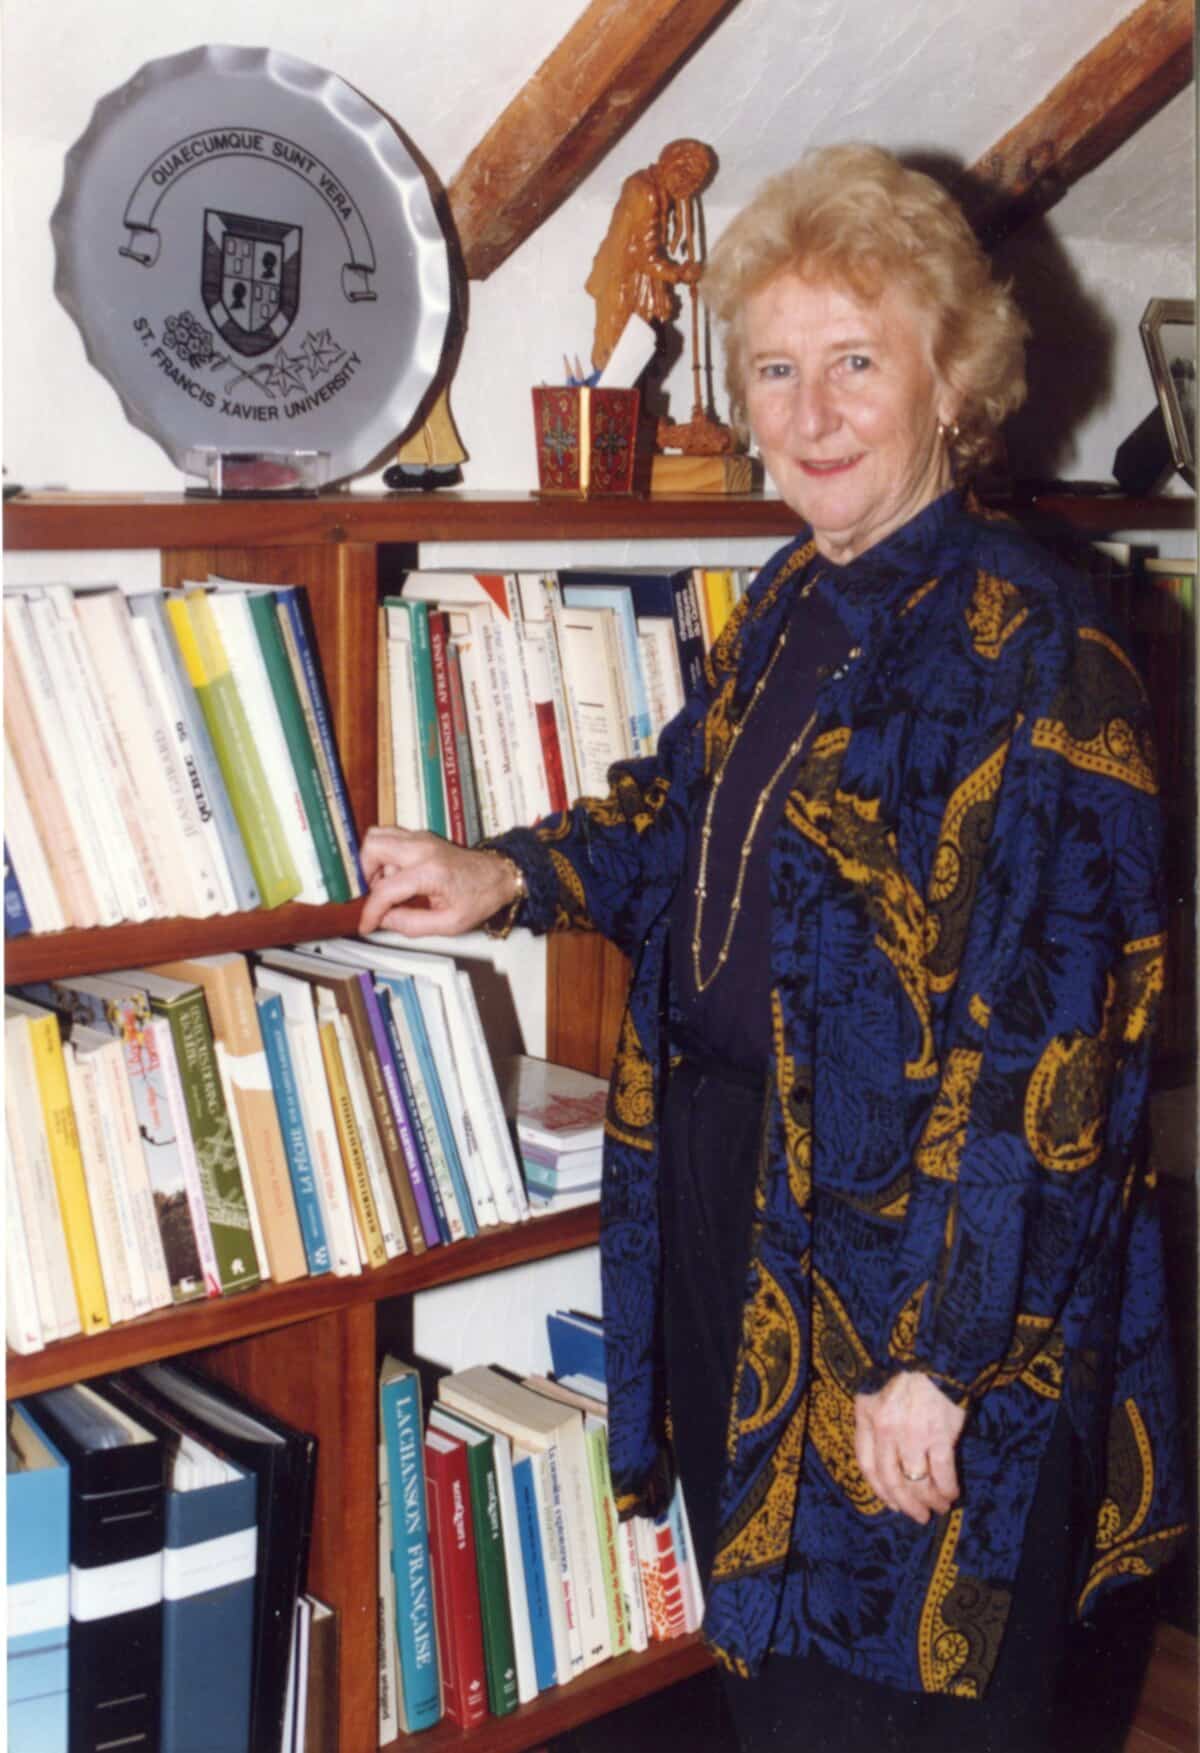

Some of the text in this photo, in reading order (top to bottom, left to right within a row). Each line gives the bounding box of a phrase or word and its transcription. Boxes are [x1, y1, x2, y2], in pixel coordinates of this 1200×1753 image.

[152, 134, 353, 220] QUAECUMQUE SUNT VERA
[134, 317, 362, 422] ST. FRANCIS XAVIER UNIVERSITY
[432, 633, 448, 704] AFRICAINES
[440, 712, 457, 775] LÉGENDES
[396, 1396, 412, 1427] LA
[398, 1428, 421, 1535] CHANSON
[407, 1545, 430, 1669] FRANÇAISE
